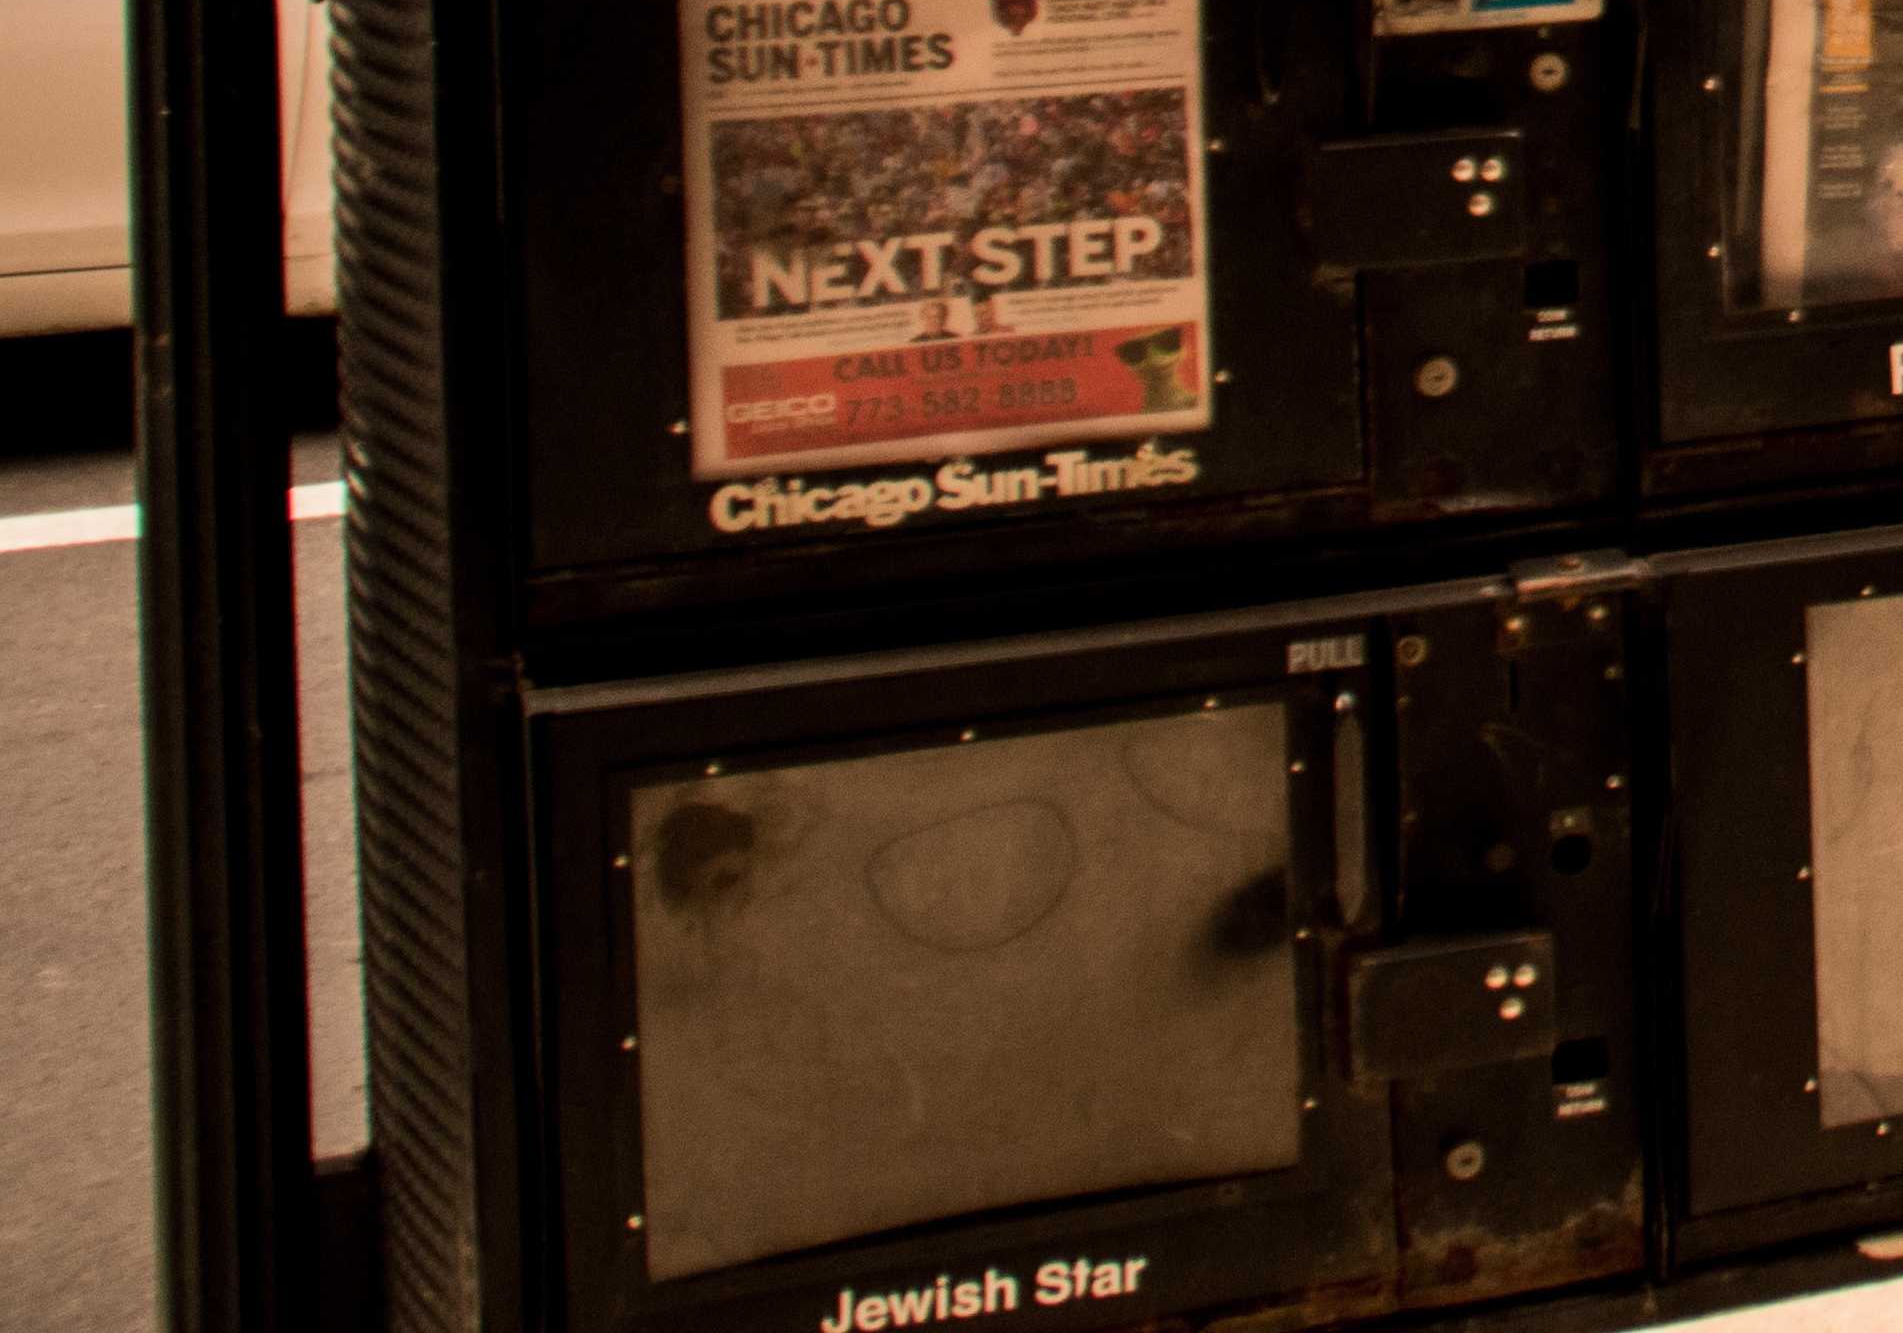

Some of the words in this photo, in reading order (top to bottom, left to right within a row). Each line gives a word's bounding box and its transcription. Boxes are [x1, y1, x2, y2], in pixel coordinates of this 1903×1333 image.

[750, 231, 956, 310] NEXT
[970, 214, 1163, 285] STEP
[833, 349, 905, 384] CALL
[919, 340, 963, 374] US
[972, 333, 1097, 369] TODAY!
[726, 392, 837, 424] GEICO
[709, 474, 933, 533] Chicago
[936, 441, 1199, 511] Sun-Times
[1286, 635, 1364, 674] PULL
[820, 1266, 1021, 1333] Jewish
[1034, 1255, 1148, 1307] Star
